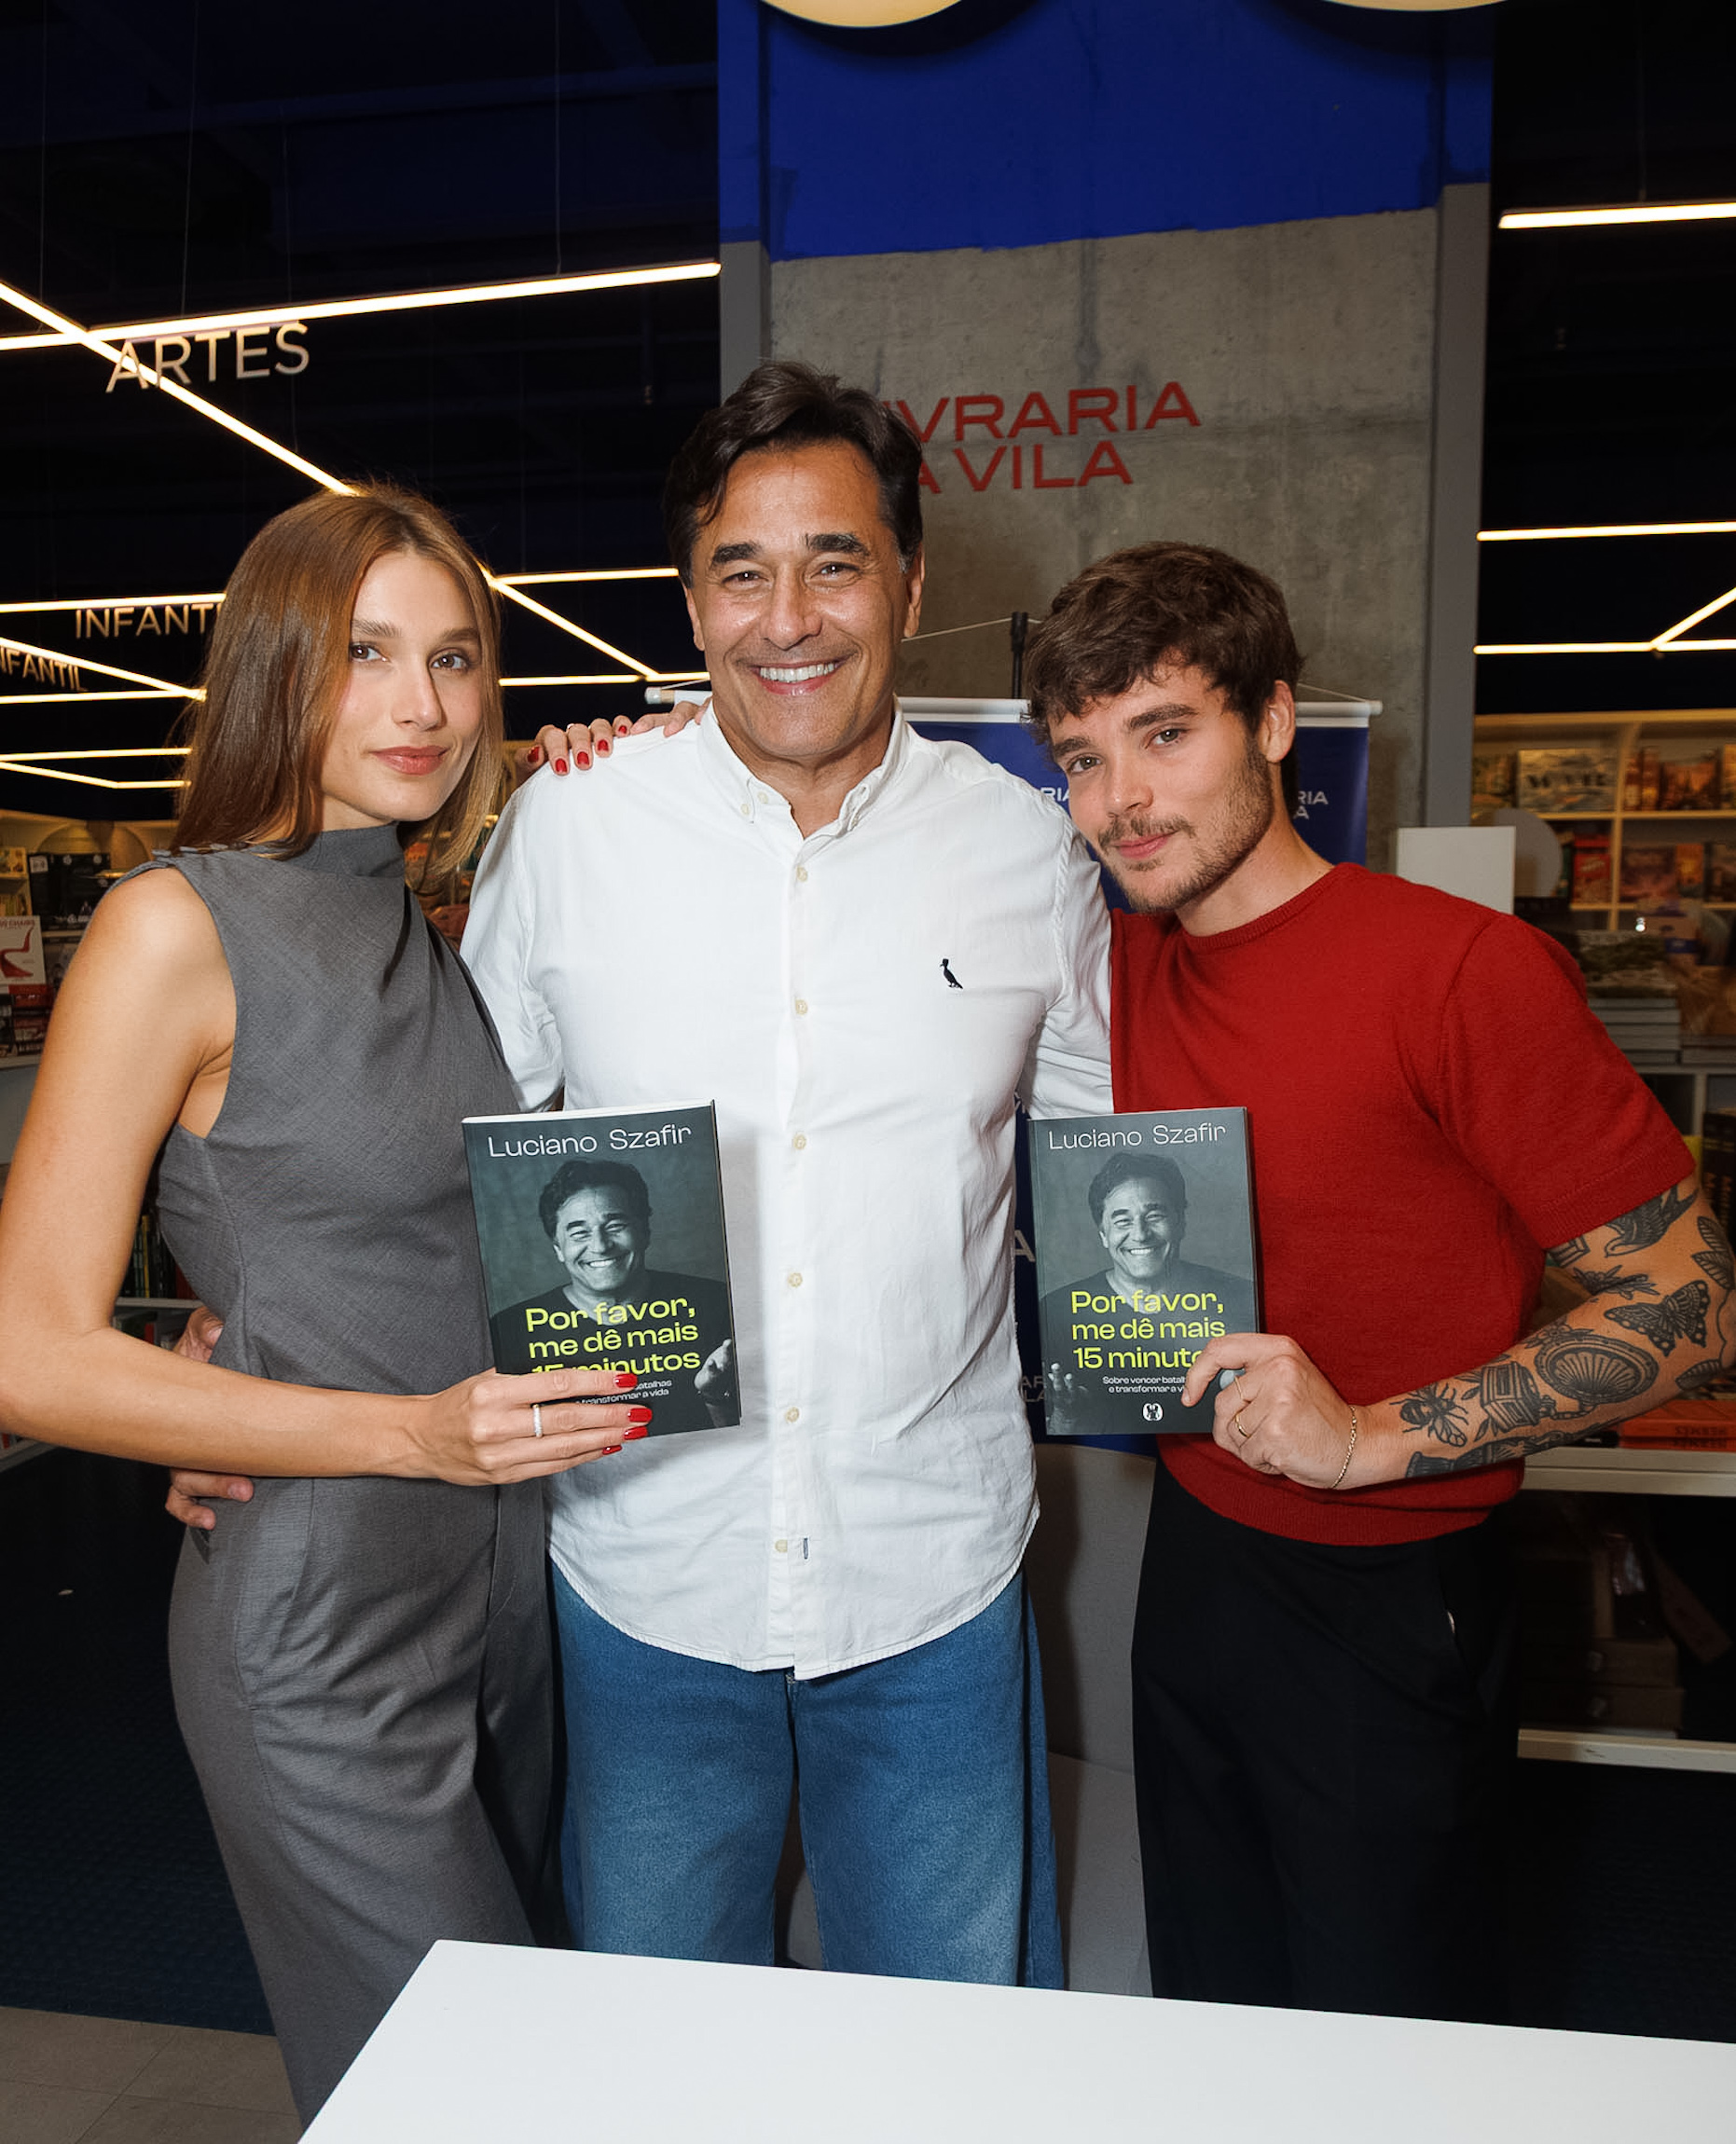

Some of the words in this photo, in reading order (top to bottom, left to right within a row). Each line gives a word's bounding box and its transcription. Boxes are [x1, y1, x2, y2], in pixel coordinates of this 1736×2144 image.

[105, 322, 310, 393] ARTES
[882, 381, 1202, 443] VRARIA
[954, 440, 1134, 492] VILA
[76, 602, 221, 639] INFANT
[489, 1134, 598, 1157] Luciano
[609, 1124, 692, 1150] Szafir
[1049, 1129, 1142, 1149] Luciano
[1152, 1122, 1226, 1145] Szafir
[525, 1308, 588, 1332] Por
[594, 1297, 696, 1326] favor,
[1071, 1291, 1126, 1313] Por
[1131, 1289, 1224, 1313] favor,
[529, 1339, 579, 1358] me
[583, 1329, 622, 1353] dê
[627, 1322, 699, 1348] mais
[1072, 1324, 1115, 1340] me
[1120, 1317, 1155, 1340] dê
[1159, 1317, 1226, 1339] mais
[1073, 1347, 1104, 1368] 15
[1108, 1347, 1203, 1368] minut
[641, 1390, 650, 1398] a
[650, 1388, 670, 1398] vida
[1102, 1376, 1129, 1385] Sobre
[1130, 1377, 1161, 1385] vencer
[1115, 1385, 1170, 1394] transformar
